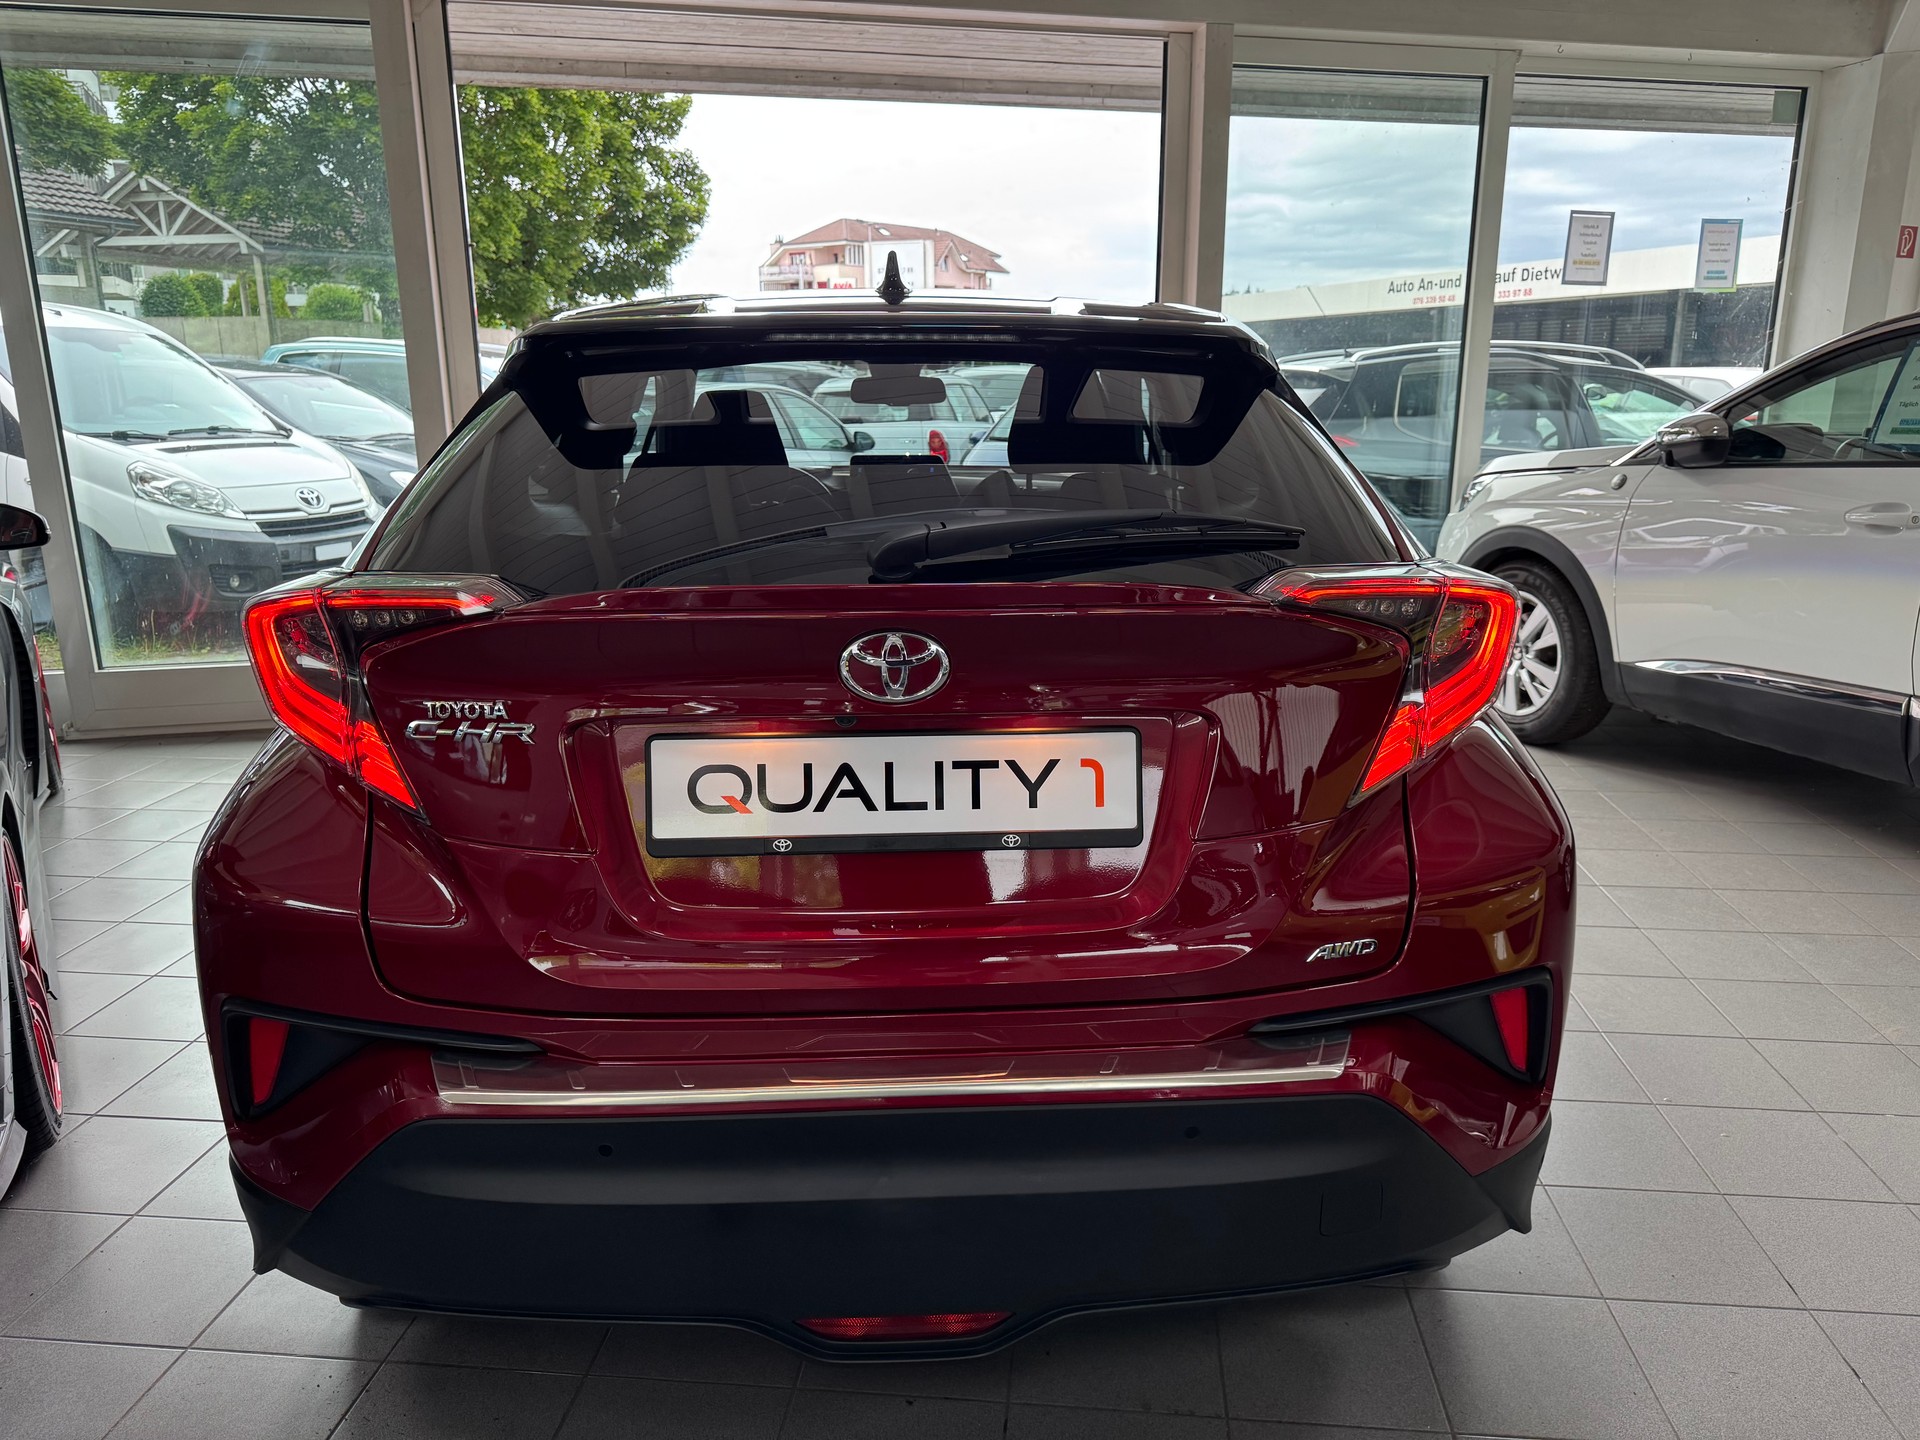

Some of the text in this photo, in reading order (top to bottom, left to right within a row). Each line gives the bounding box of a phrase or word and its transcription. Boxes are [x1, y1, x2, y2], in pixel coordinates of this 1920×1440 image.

[1388, 266, 1562, 294] Auto An-und auf Dietw
[423, 700, 509, 719] TOYOTA
[404, 720, 535, 744] C-HR
[687, 758, 1105, 815] QUALITY 1
[1306, 938, 1378, 962] AWD
